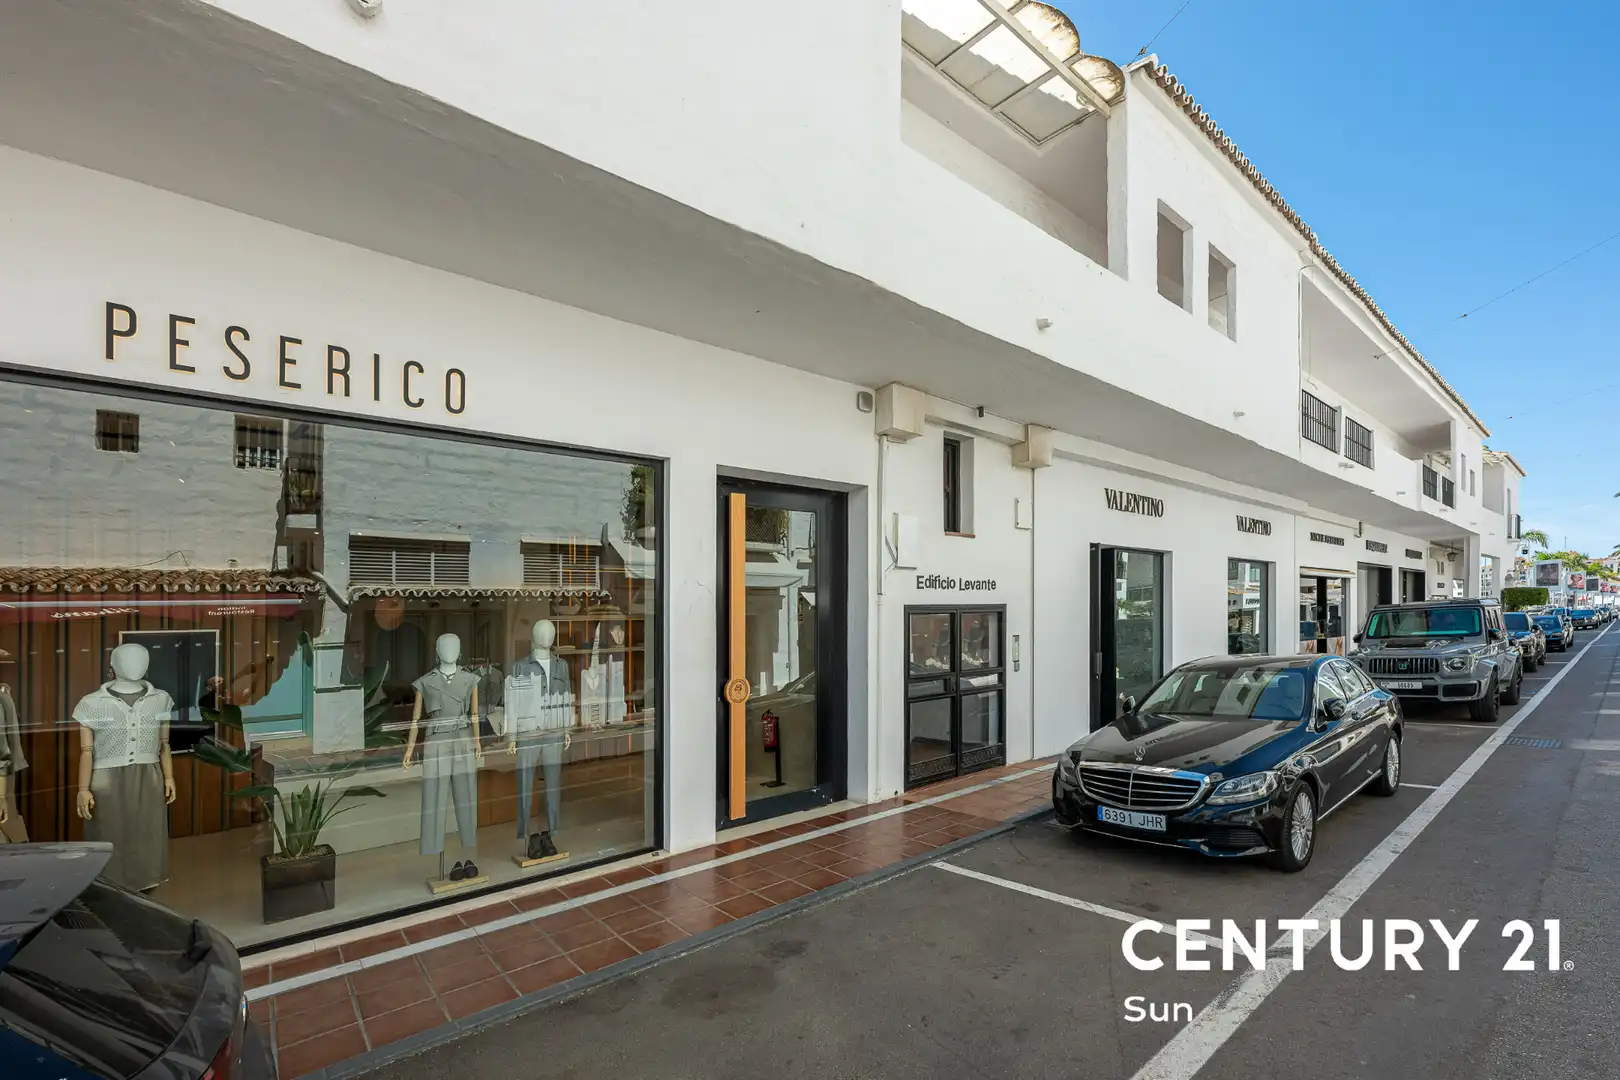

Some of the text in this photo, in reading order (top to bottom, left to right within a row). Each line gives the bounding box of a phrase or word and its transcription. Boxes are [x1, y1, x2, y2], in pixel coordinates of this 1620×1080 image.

[105, 301, 467, 415] PESERICO
[1104, 487, 1164, 518] VALENTINO
[1235, 514, 1272, 537] VALENTINO
[916, 574, 997, 591] Edificio Levante
[1104, 808, 1163, 829] 6391 JHR
